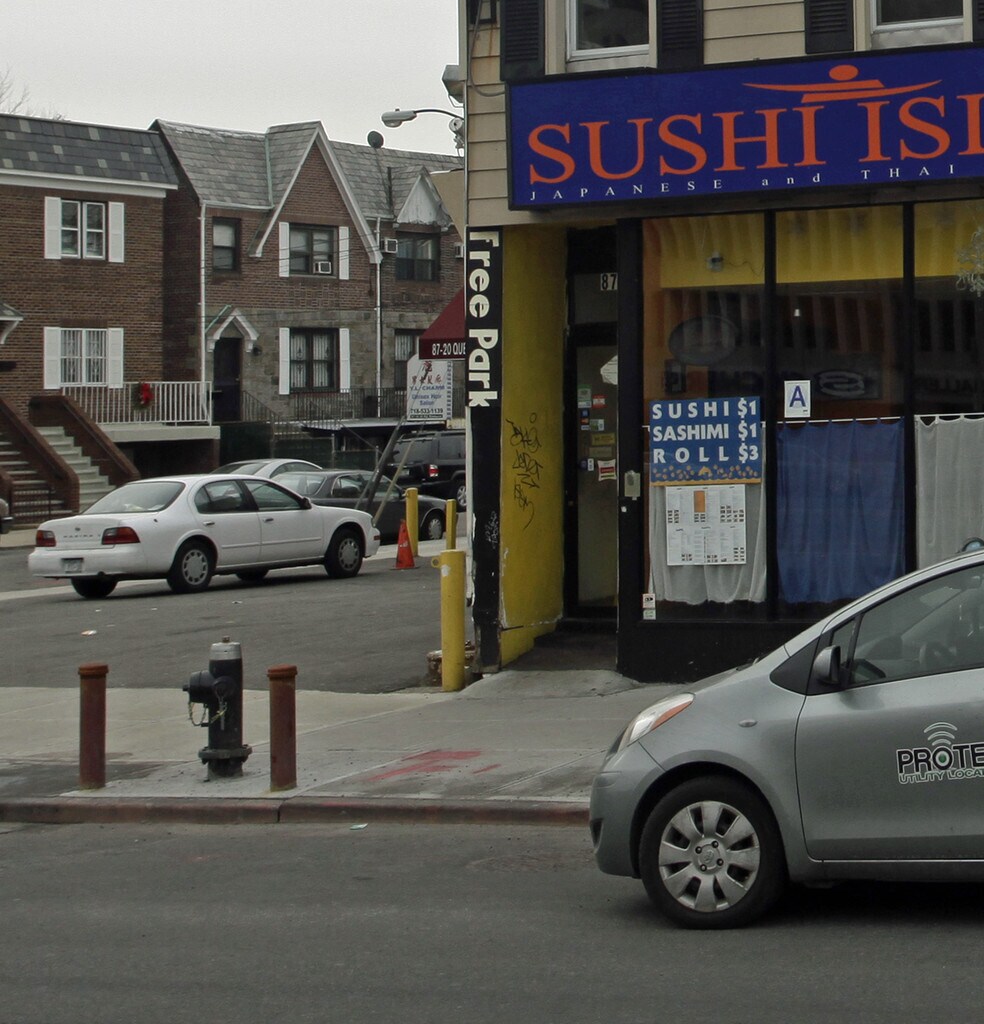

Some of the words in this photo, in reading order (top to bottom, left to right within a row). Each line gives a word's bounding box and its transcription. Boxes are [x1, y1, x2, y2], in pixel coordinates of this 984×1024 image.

[528, 104, 827, 186] SUSHI
[530, 179, 723, 202] JAPANESE
[761, 172, 821, 186] and
[861, 164, 954, 180] THAI
[602, 274, 616, 290] 87
[432, 343, 452, 356] 87-20
[468, 329, 499, 407] Park
[789, 385, 806, 407] A
[652, 401, 729, 419] SUSHI
[737, 397, 757, 418] $1
[653, 423, 729, 442] SASHIMI
[738, 420, 757, 441] $1
[653, 446, 729, 464] ROLL
[739, 443, 759, 464] $3
[899, 770, 945, 784] UTILITY
